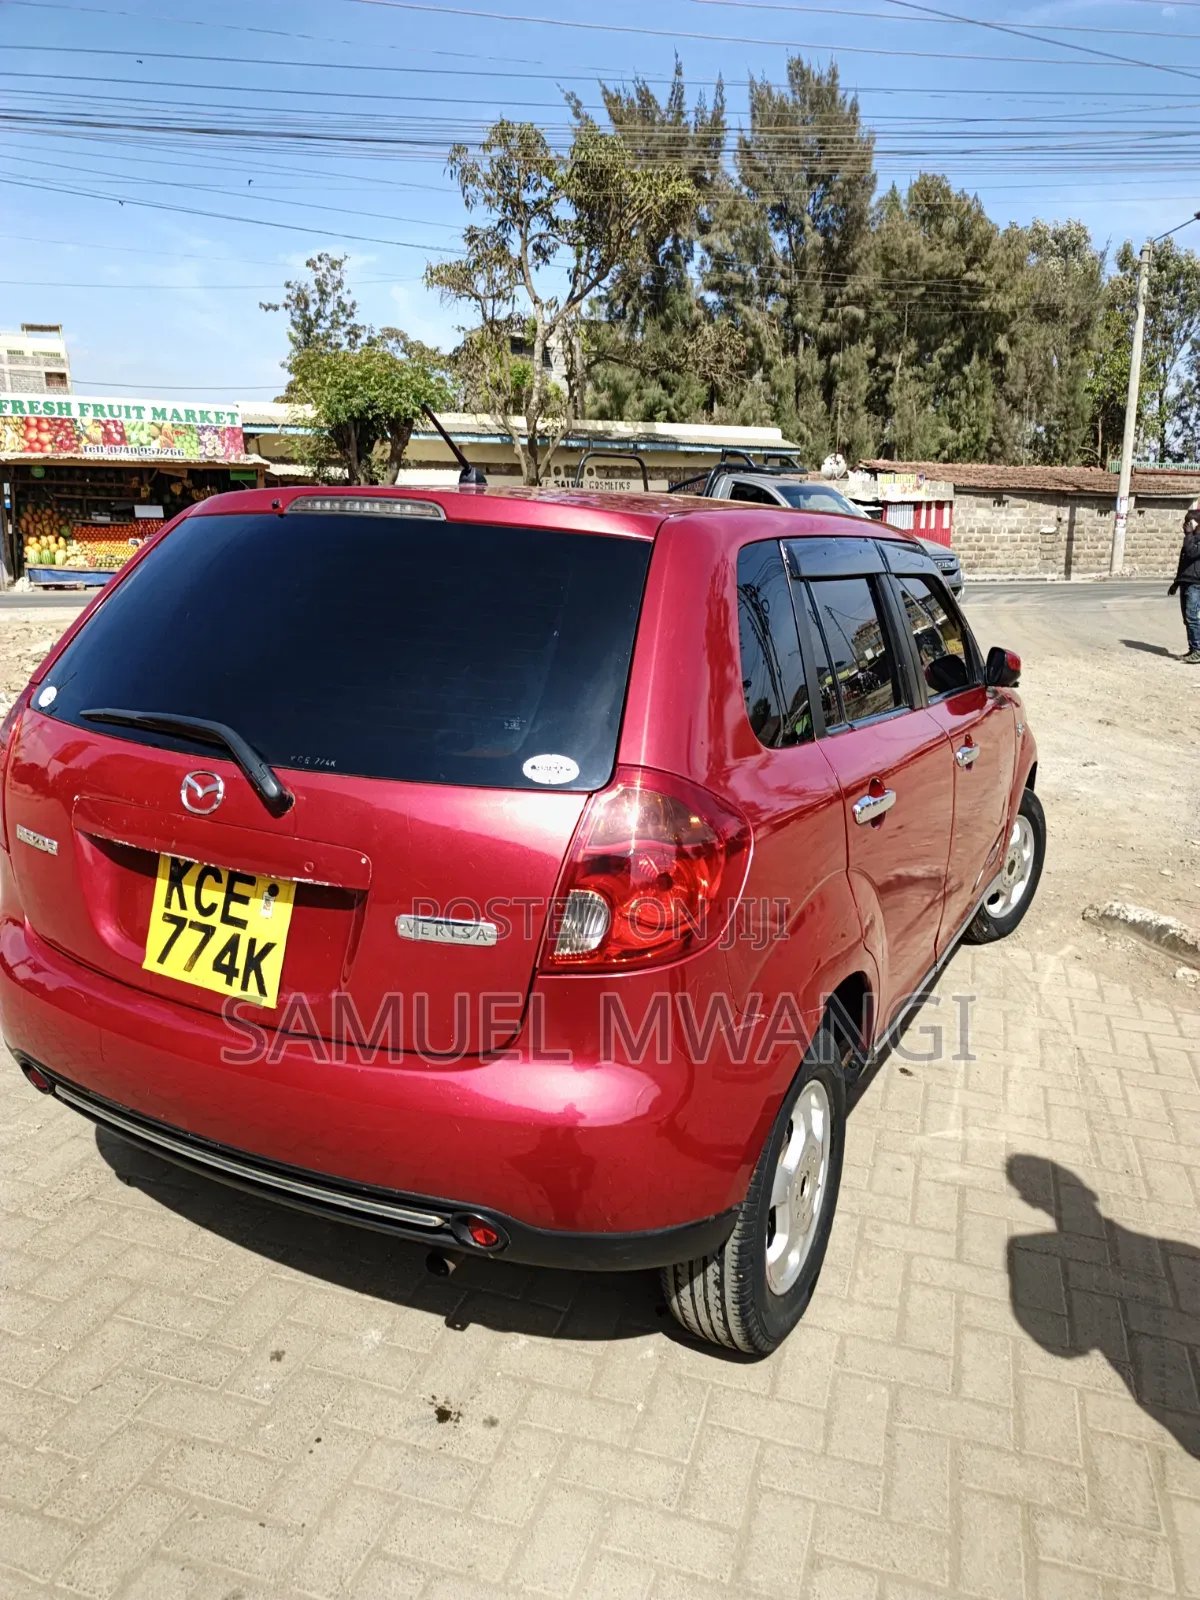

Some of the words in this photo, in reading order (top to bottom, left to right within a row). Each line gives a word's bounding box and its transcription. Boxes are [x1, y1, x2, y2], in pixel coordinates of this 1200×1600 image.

[0, 399, 73, 416] FRESH
[78, 402, 146, 420] FRUIT
[151, 406, 239, 426] MARKET
[164, 856, 257, 931] KCE
[156, 912, 277, 997] 774K
[406, 920, 488, 942] VERISA
